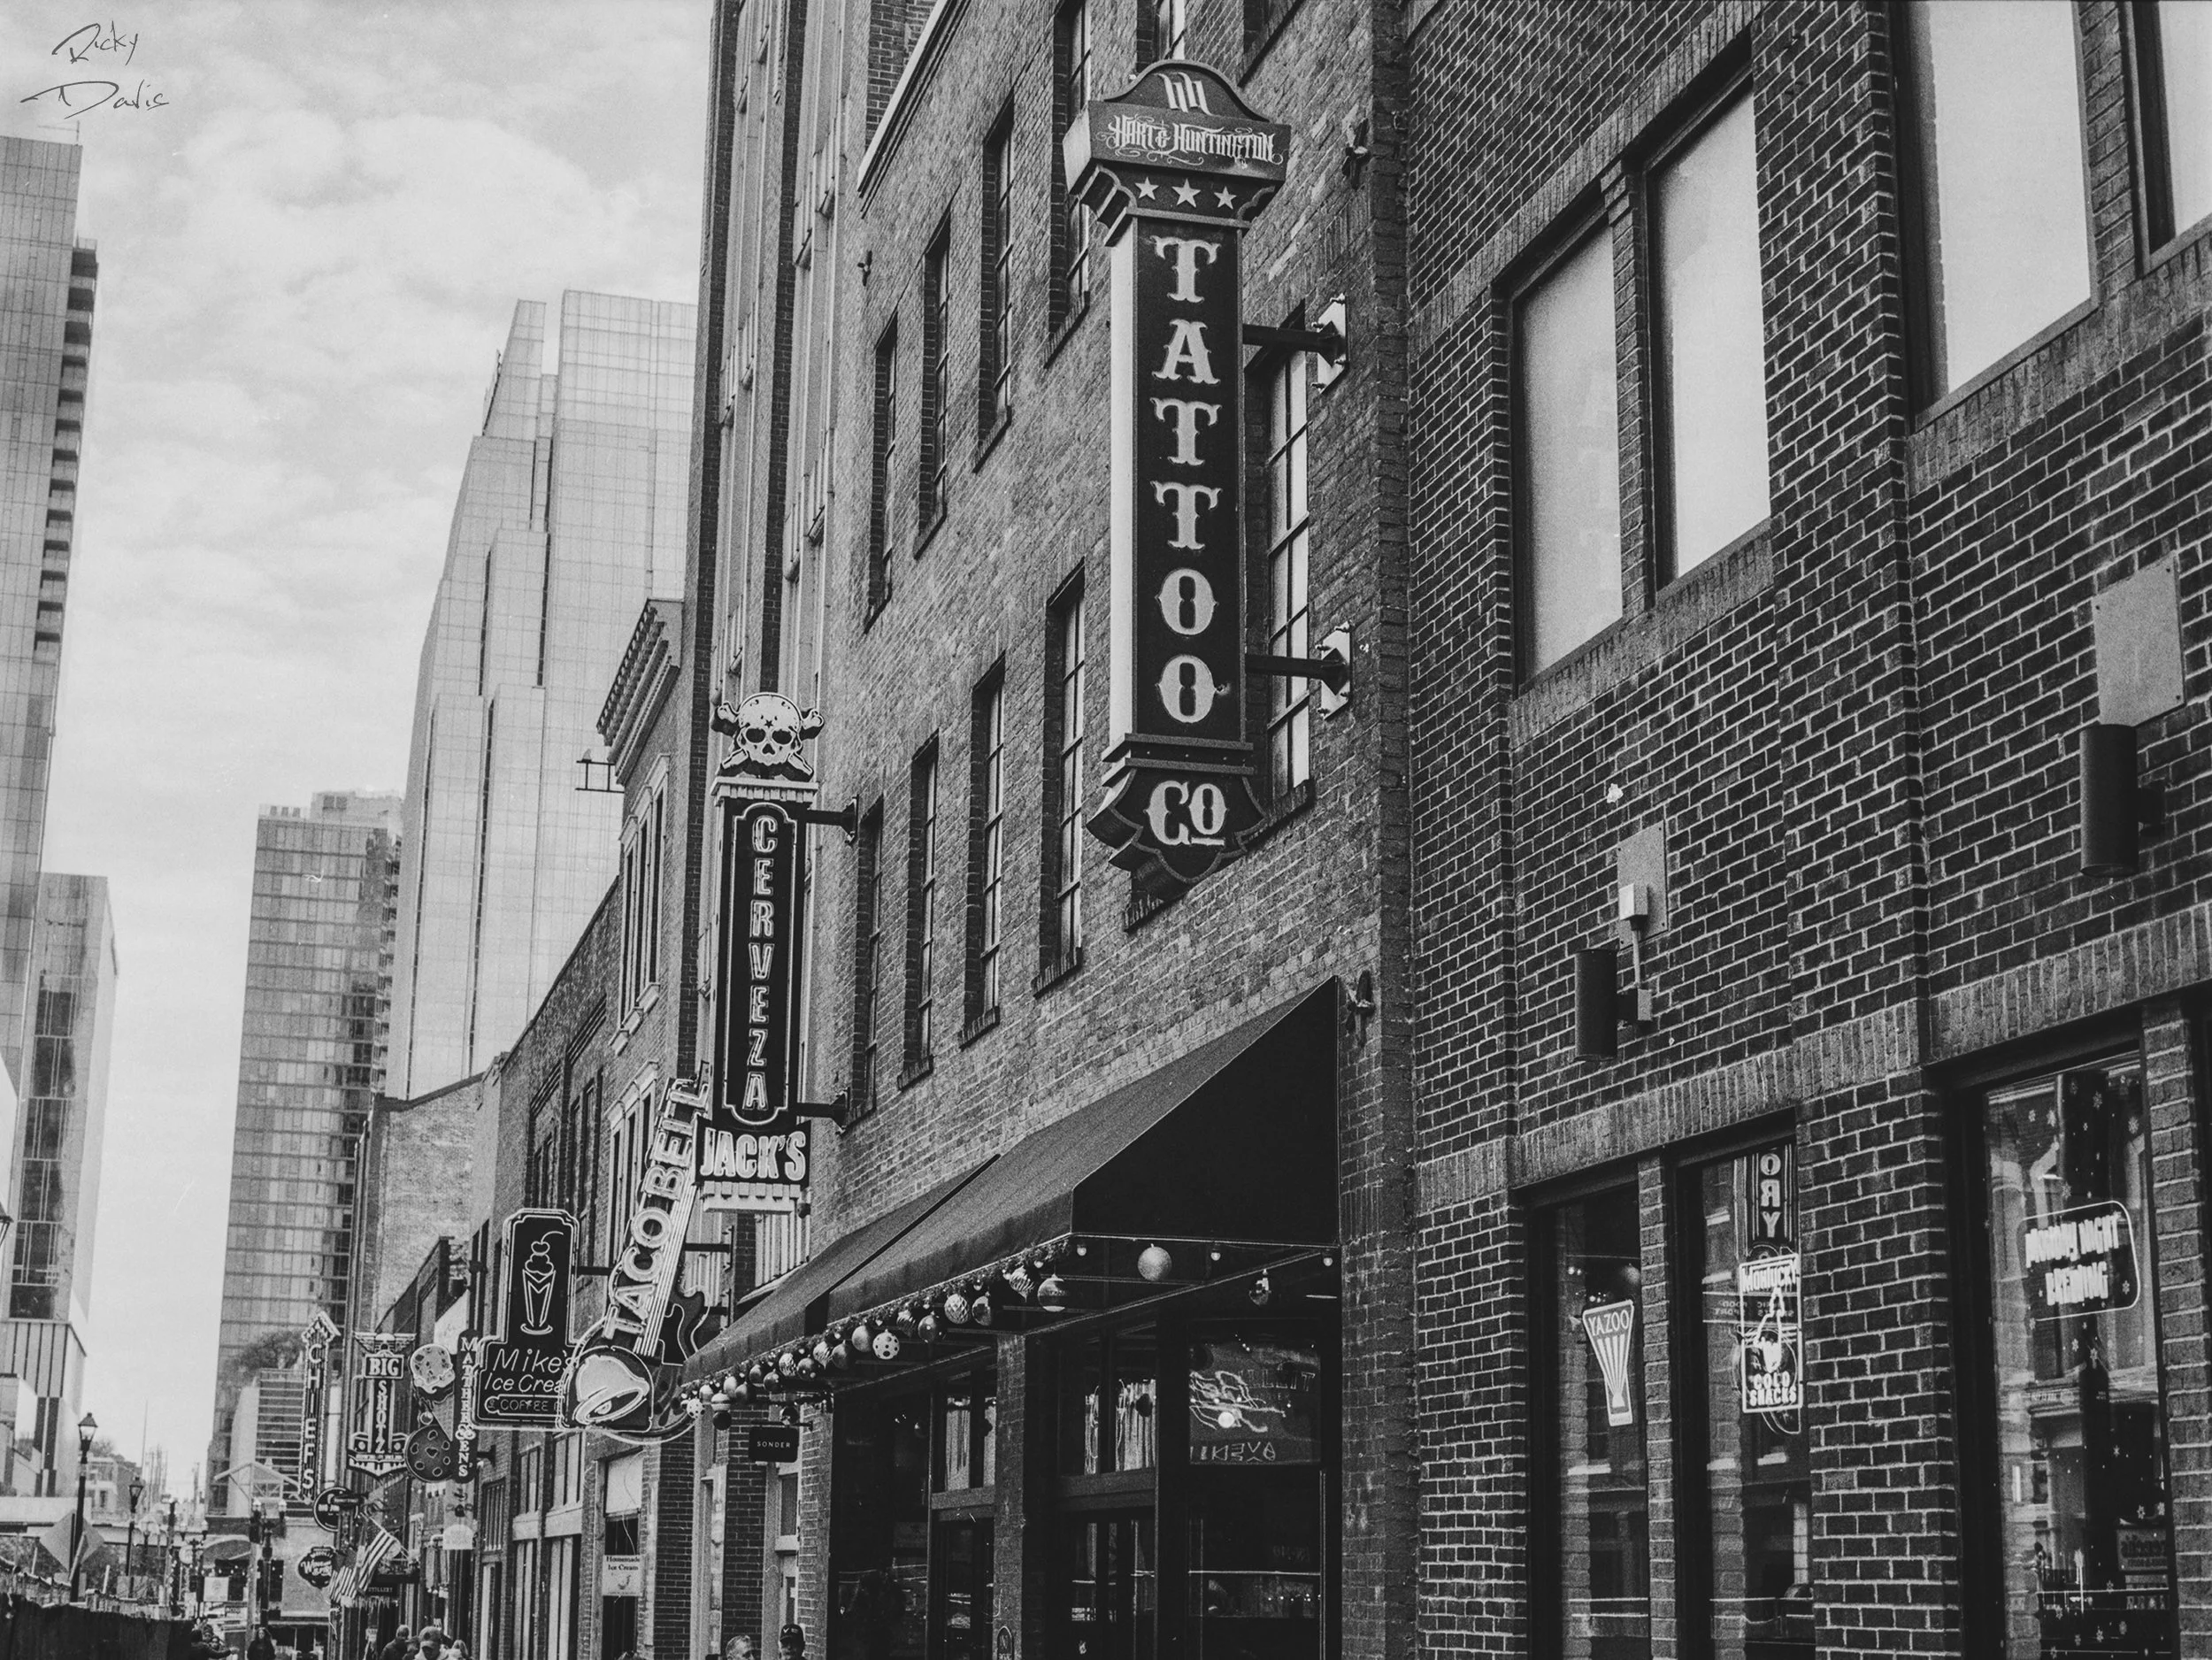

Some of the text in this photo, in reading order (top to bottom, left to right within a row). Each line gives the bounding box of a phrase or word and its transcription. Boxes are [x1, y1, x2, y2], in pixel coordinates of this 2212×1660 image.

[1149, 235, 1223, 724] TATTOO
[741, 815, 778, 1111] CERVEZA
[700, 1127, 806, 1181] JACK'S
[602, 1080, 709, 1340] TACO BELL
[1588, 1309, 1630, 1336] YAZOO
[369, 1357, 399, 1377] BIG
[493, 1348, 574, 1373] Mike's
[484, 1372, 565, 1393] Ice Crea
[1753, 1372, 1791, 1389] COLD
[500, 1398, 549, 1411] COFFEE
[1749, 1385, 1798, 1407] SNACKS
[302, 1343, 322, 1490] CHIEFS
[374, 1380, 388, 1455] SHOTZ
